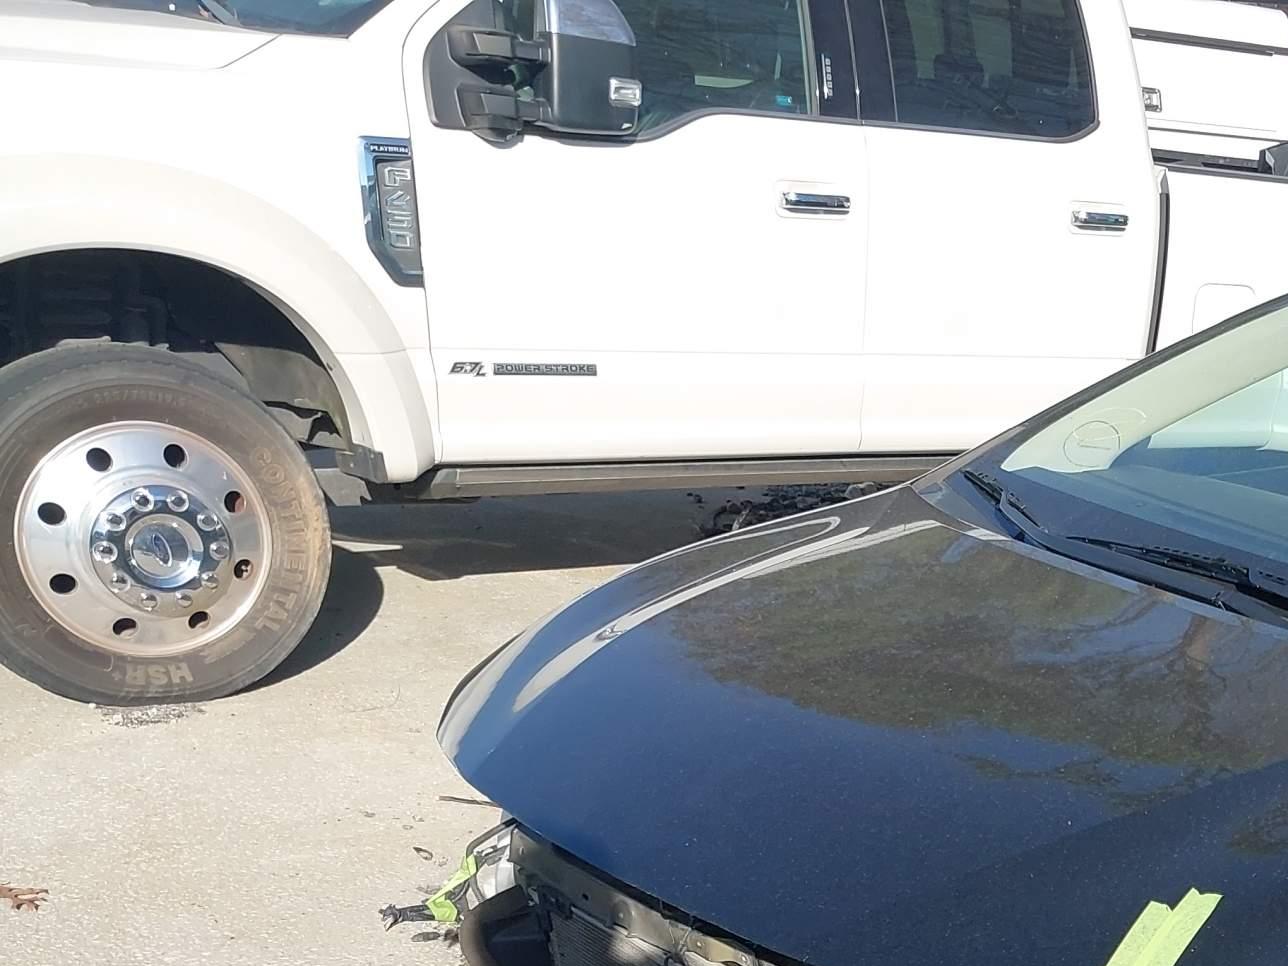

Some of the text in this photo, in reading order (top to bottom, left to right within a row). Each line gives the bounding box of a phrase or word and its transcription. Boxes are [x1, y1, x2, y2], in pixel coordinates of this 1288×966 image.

[370, 144, 409, 154] PLATINUM
[450, 361, 594, 377] 6.7L POWER STROKE
[255, 450, 305, 631] CONTINENTAL
